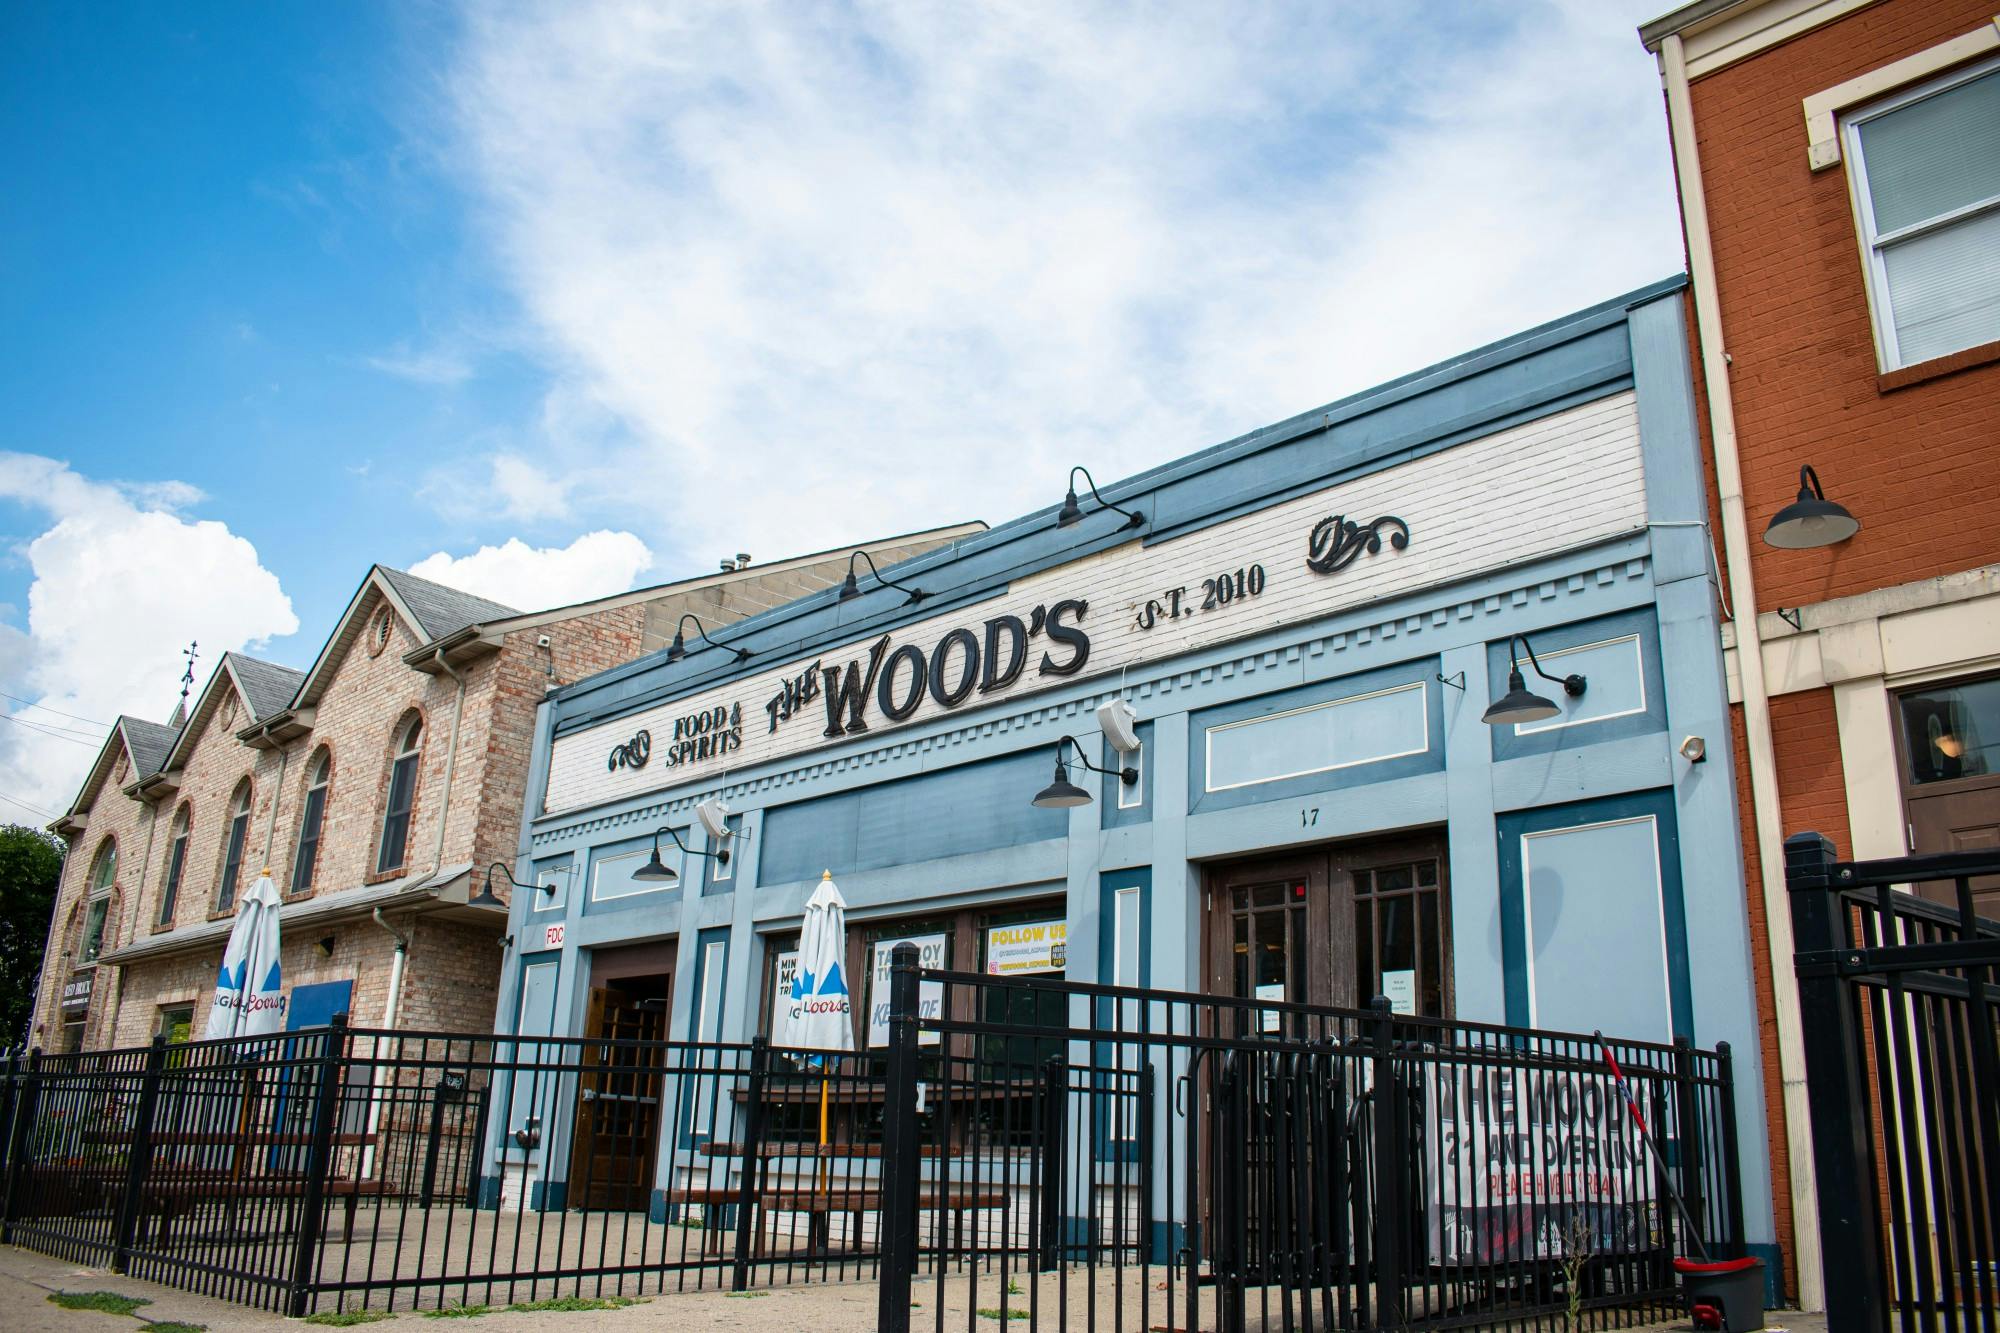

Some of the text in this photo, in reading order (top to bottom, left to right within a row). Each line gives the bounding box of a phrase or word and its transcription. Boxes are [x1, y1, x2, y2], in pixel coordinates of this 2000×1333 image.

[1201, 563, 1265, 610] 2010
[765, 599, 1090, 736] THE WOOD'S
[673, 701, 742, 740] FOOD &
[666, 727, 742, 768] SPIRITS
[1301, 808, 1319, 828] 17
[547, 927, 563, 944] FDC
[992, 924, 1066, 945] FOLLOW US
[1490, 1173, 1531, 1198] PLEAE
[1536, 1173, 1560, 1197] HVE
